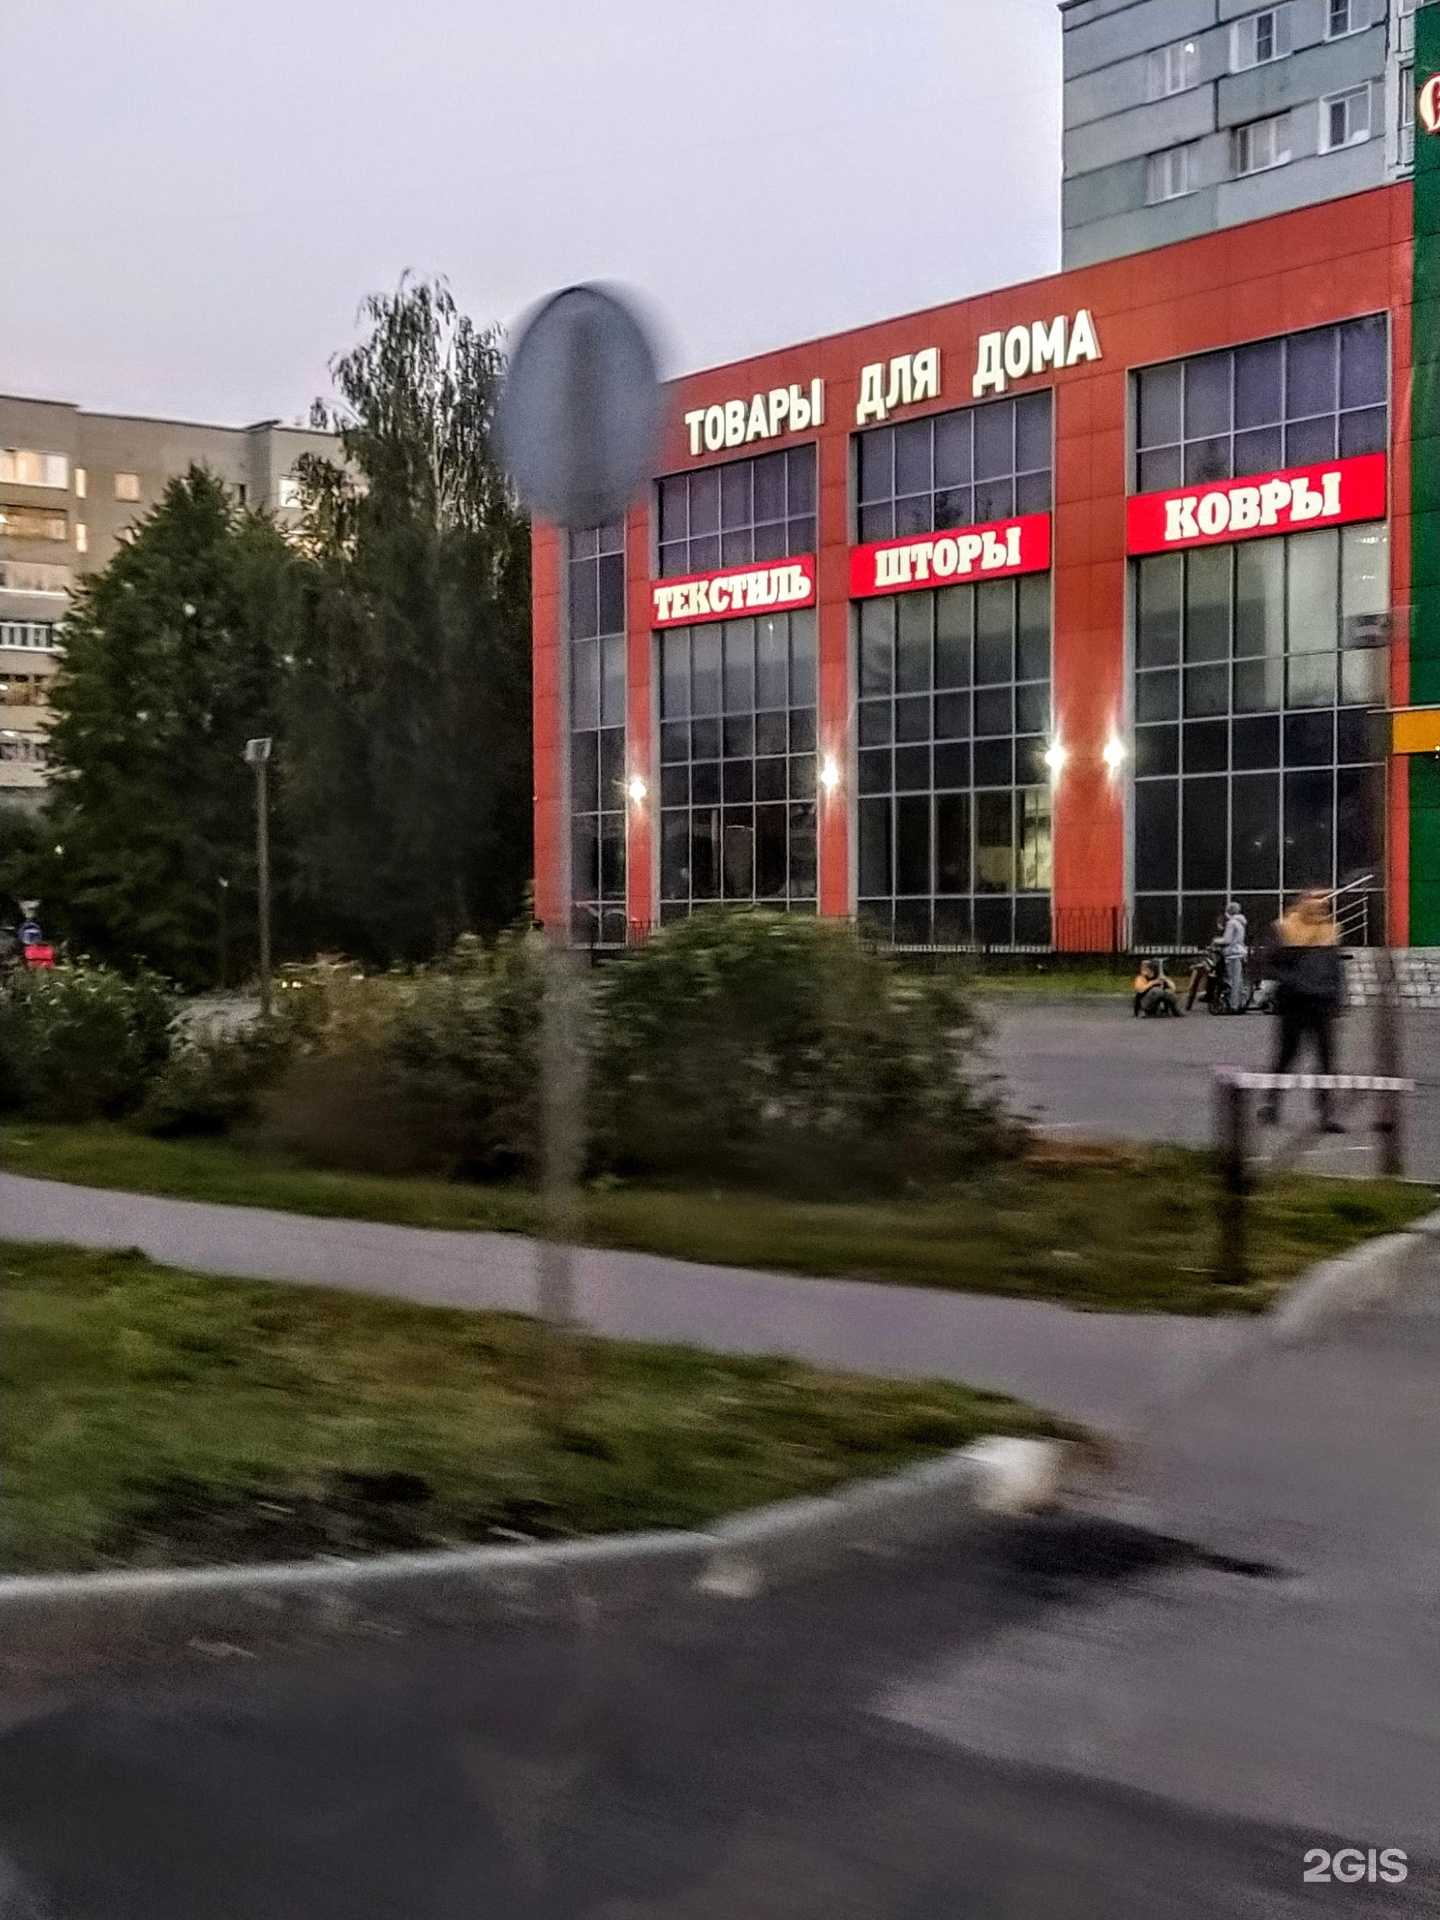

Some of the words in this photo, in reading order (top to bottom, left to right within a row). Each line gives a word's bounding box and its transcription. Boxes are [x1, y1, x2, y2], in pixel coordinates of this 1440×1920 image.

[684, 378, 824, 456] ТОВАРЫ
[856, 347, 940, 425] ДЛЯ
[972, 309, 1102, 398] ДОМА
[1164, 471, 1342, 541] КОВРЫ
[874, 526, 1021, 588] ШТОРЫ
[653, 564, 812, 621] ТЕКСТИЛЬ
